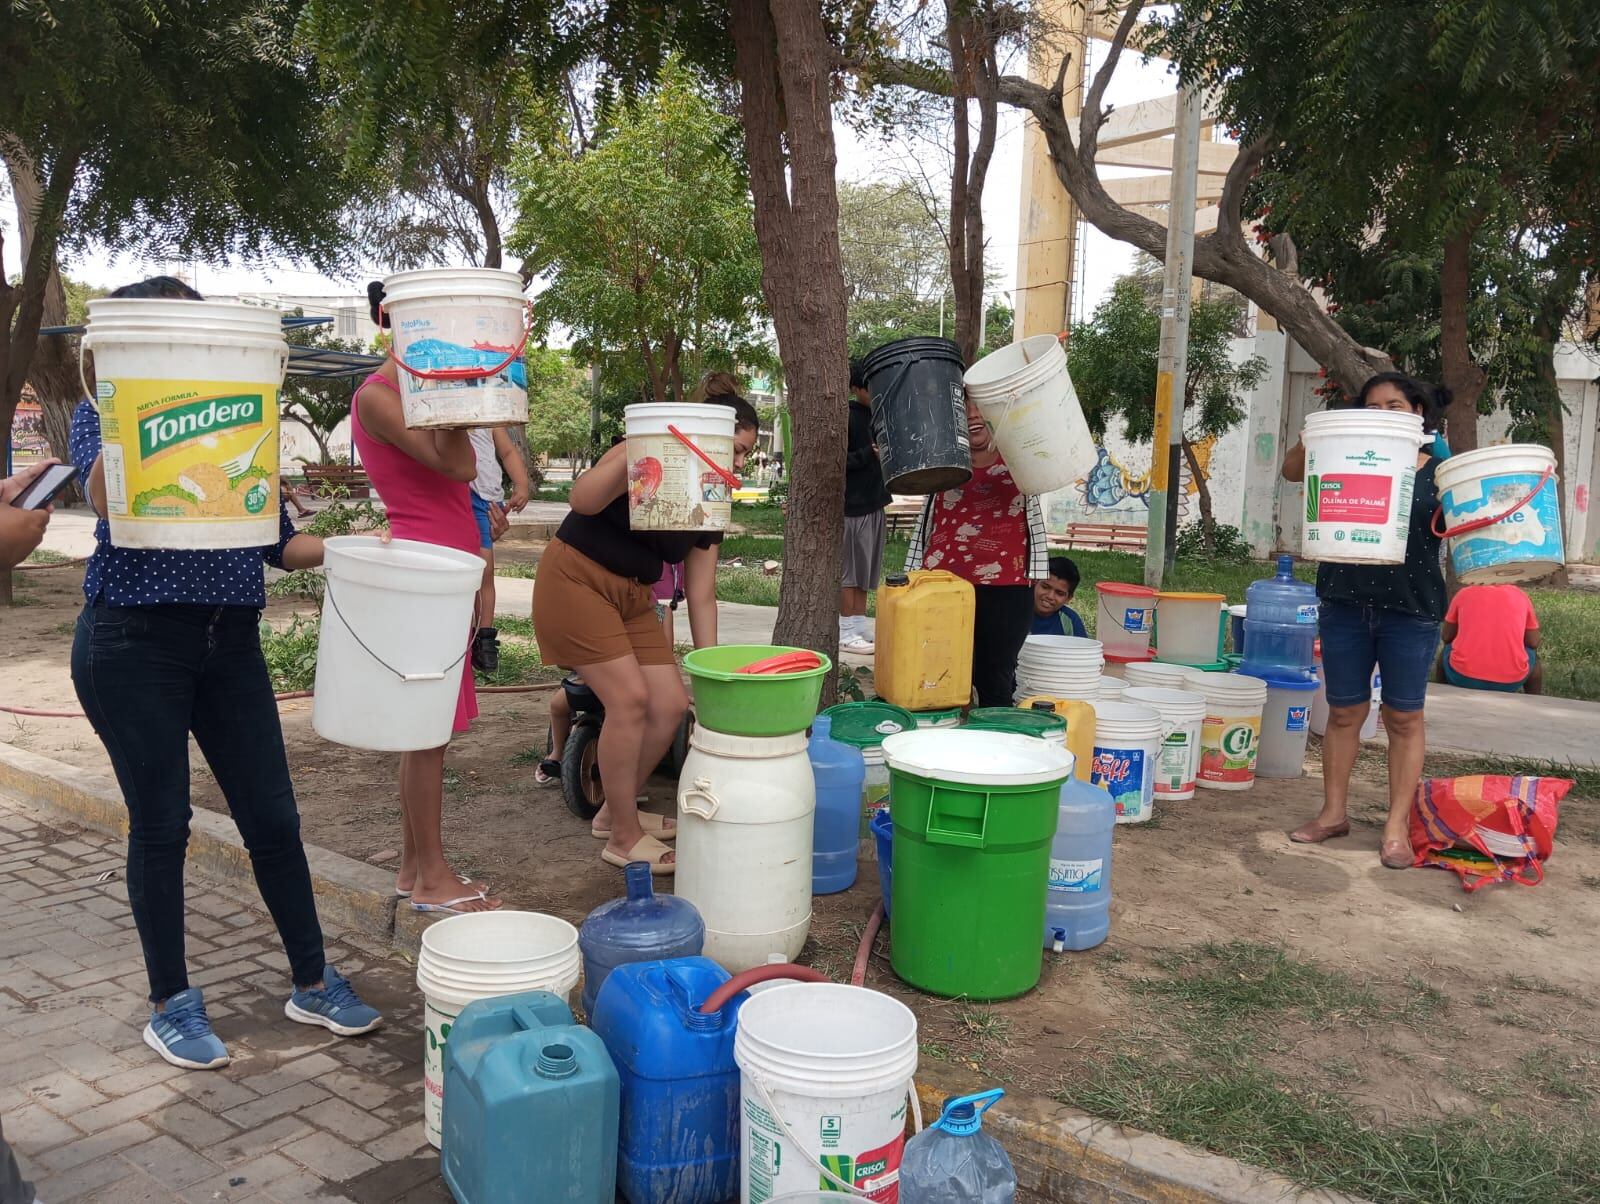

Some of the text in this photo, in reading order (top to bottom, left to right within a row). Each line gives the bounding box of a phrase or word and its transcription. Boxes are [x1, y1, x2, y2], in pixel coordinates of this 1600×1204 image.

[137, 400, 160, 412] NUEVA
[144, 401, 254, 448] Tondero
[1360, 498, 1385, 506] PALMA
[827, 1119, 835, 1128] 5
[857, 1163, 886, 1177] CRISOL
